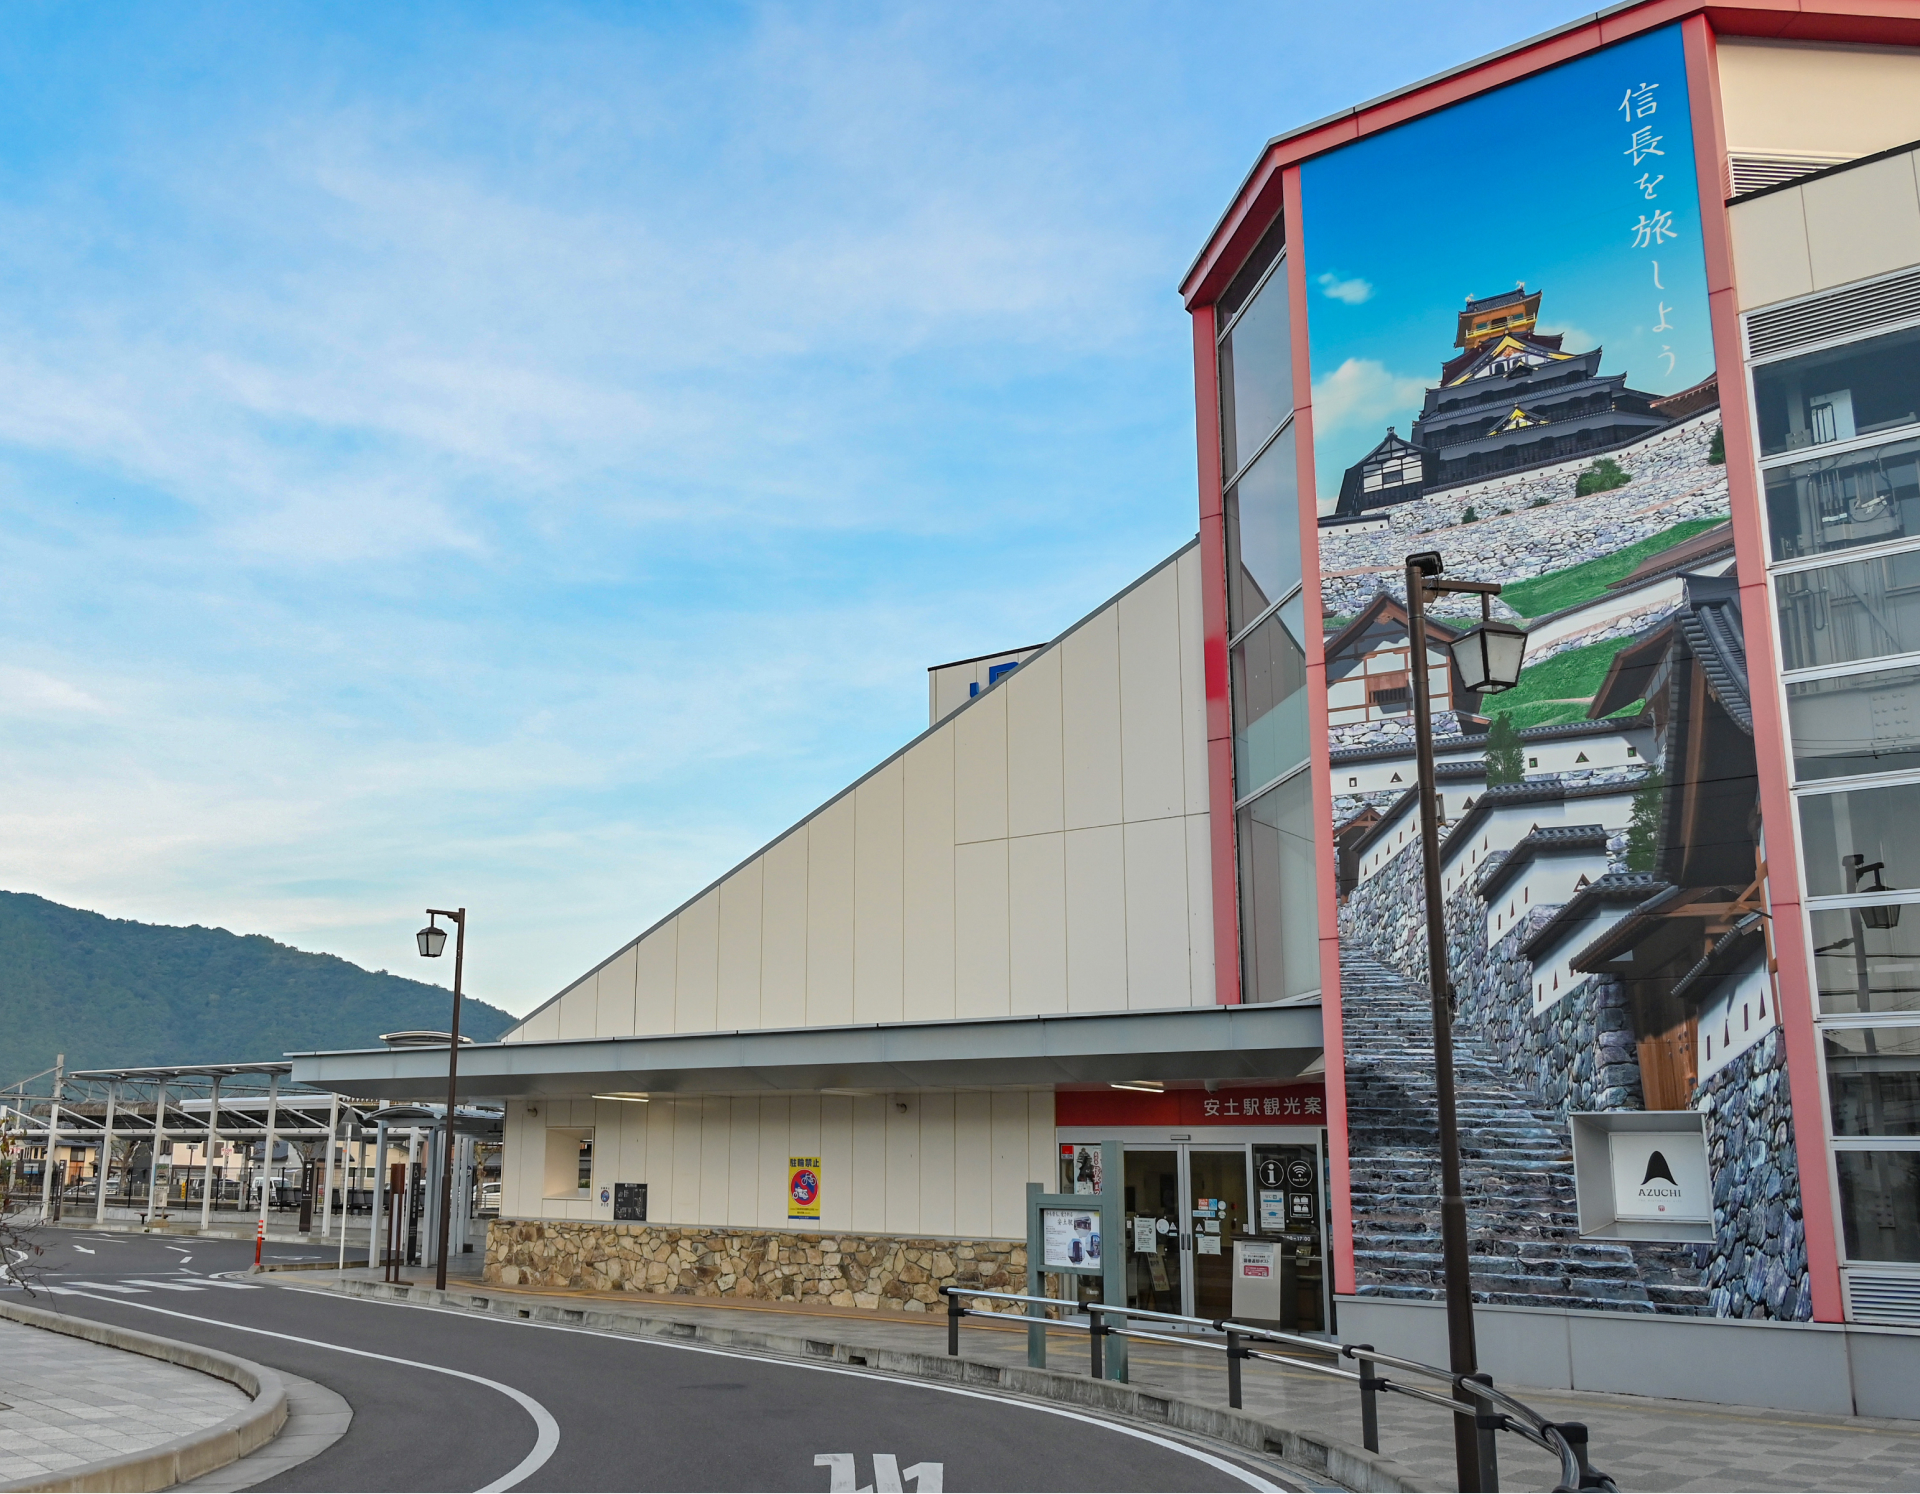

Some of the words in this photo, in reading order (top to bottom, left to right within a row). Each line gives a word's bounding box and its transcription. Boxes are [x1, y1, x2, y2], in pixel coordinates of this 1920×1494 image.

[1618, 82, 1677, 377] 信長を旅しよう
[1204, 1097, 1322, 1117] 安土駅観光案
[1638, 1188, 1682, 1197] AZUCHI
